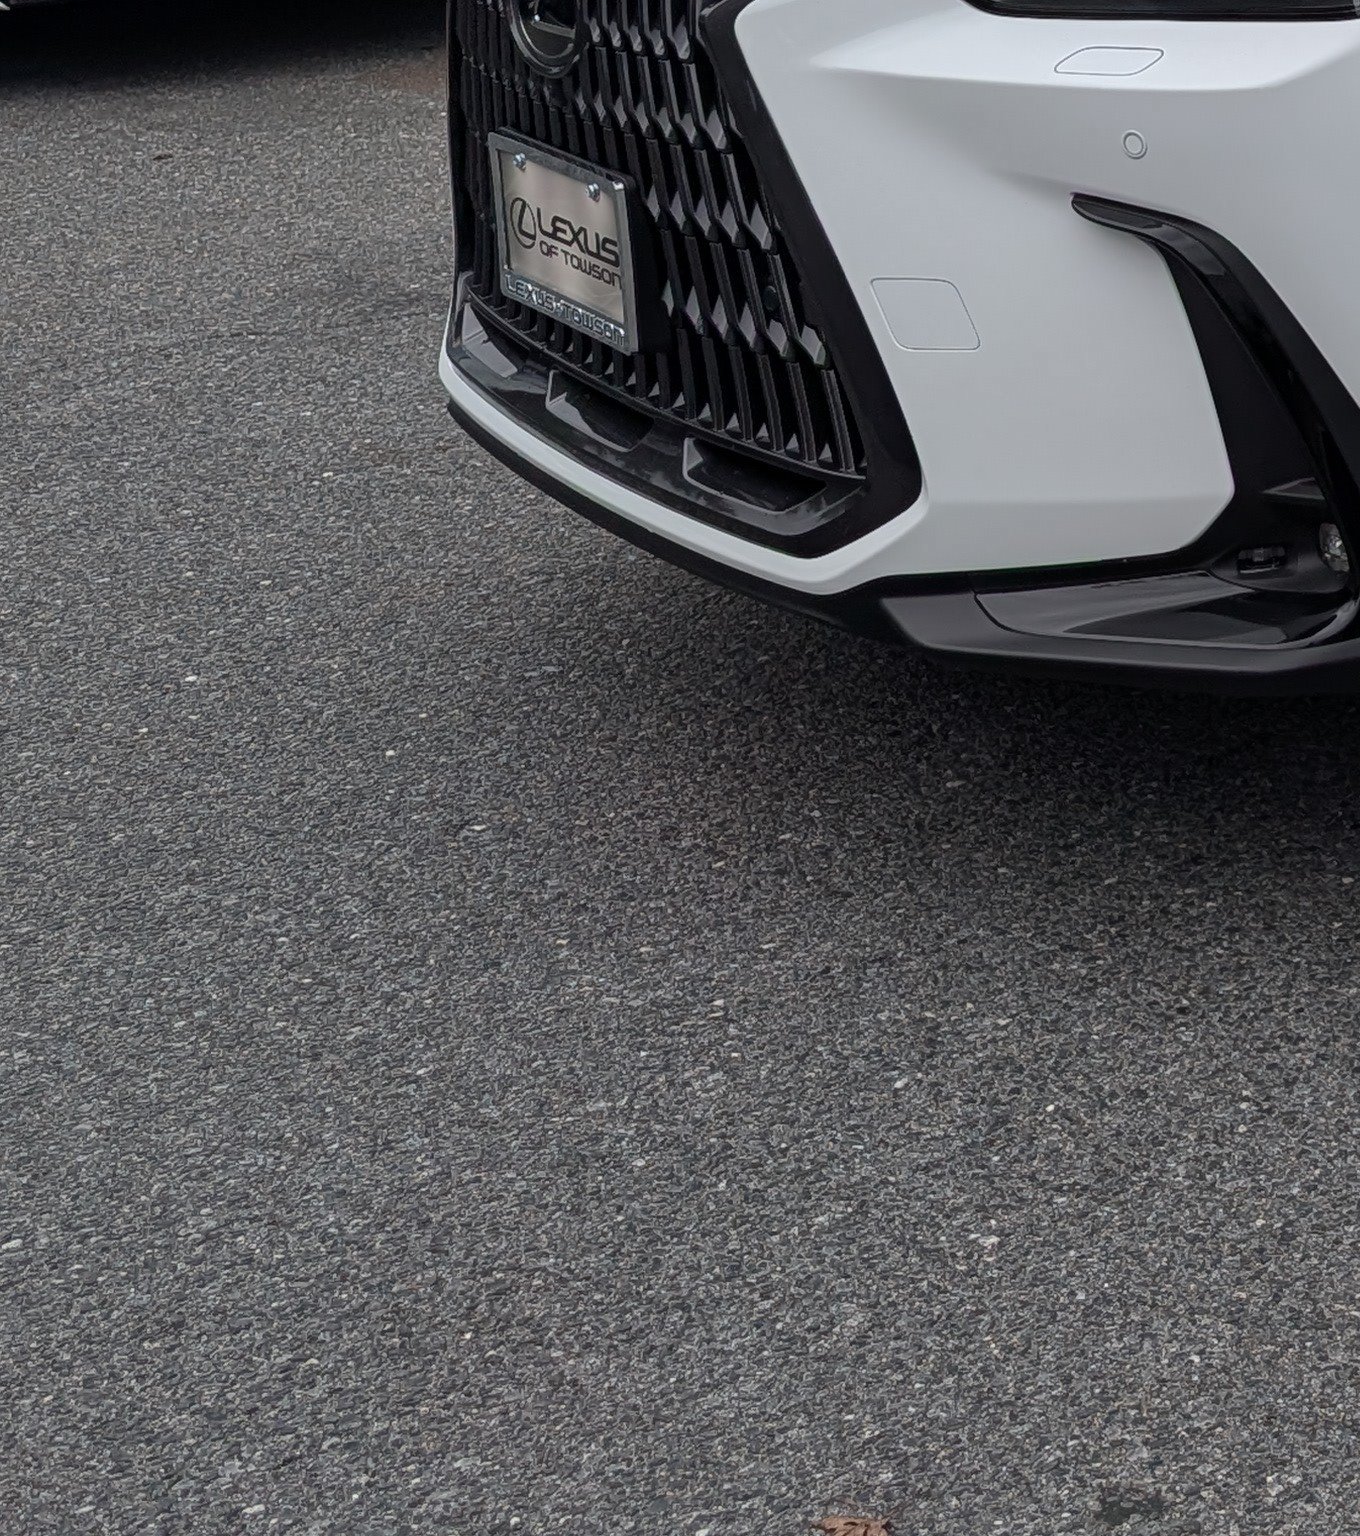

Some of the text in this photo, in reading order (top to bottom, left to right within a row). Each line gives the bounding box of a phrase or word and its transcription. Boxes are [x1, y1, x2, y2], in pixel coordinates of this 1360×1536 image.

[537, 208, 620, 268] LEXUS
[539, 240, 622, 290] OF TOWSON
[505, 274, 625, 346] LEXUS TOWSON
